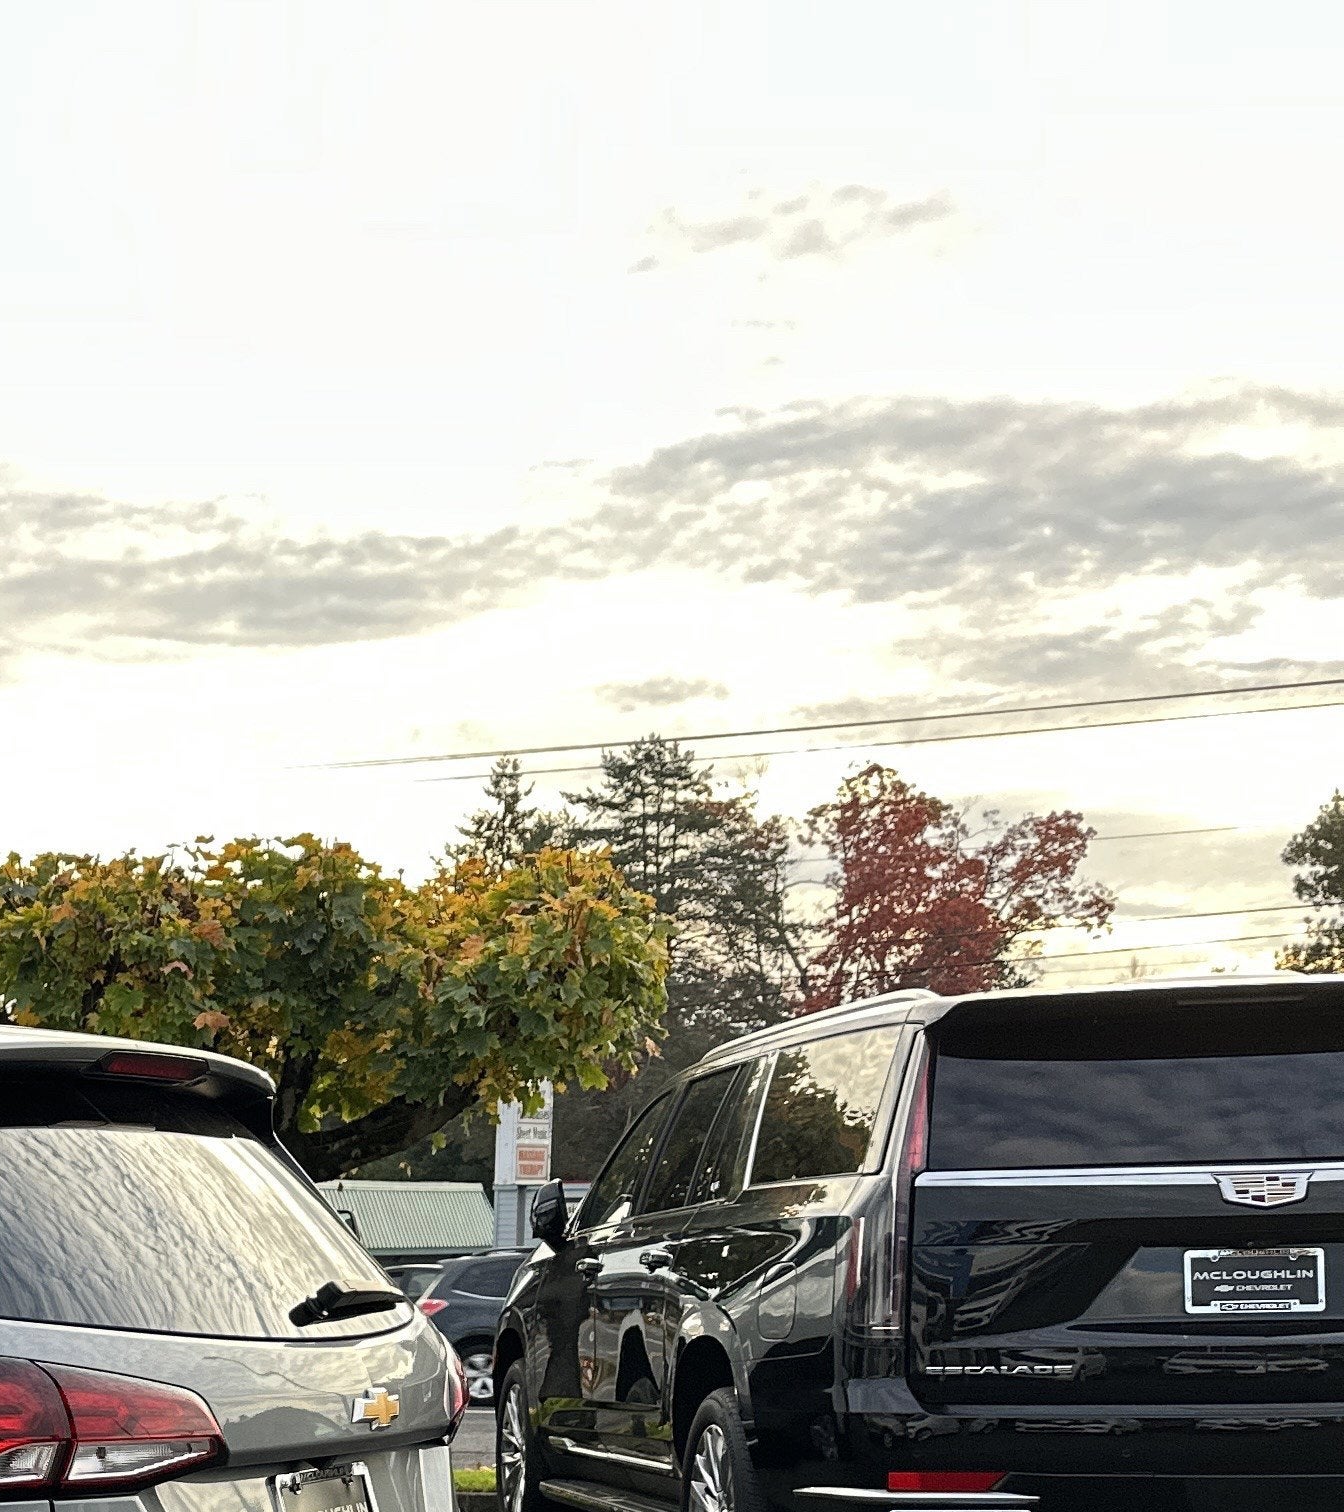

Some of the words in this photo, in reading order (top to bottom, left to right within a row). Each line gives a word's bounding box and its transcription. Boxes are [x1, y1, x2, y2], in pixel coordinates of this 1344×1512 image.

[1192, 1269, 1314, 1281] MCLOUGHLIN
[1235, 1284, 1293, 1292] CHEVROLET
[925, 1365, 1073, 1375] ESCALADE
